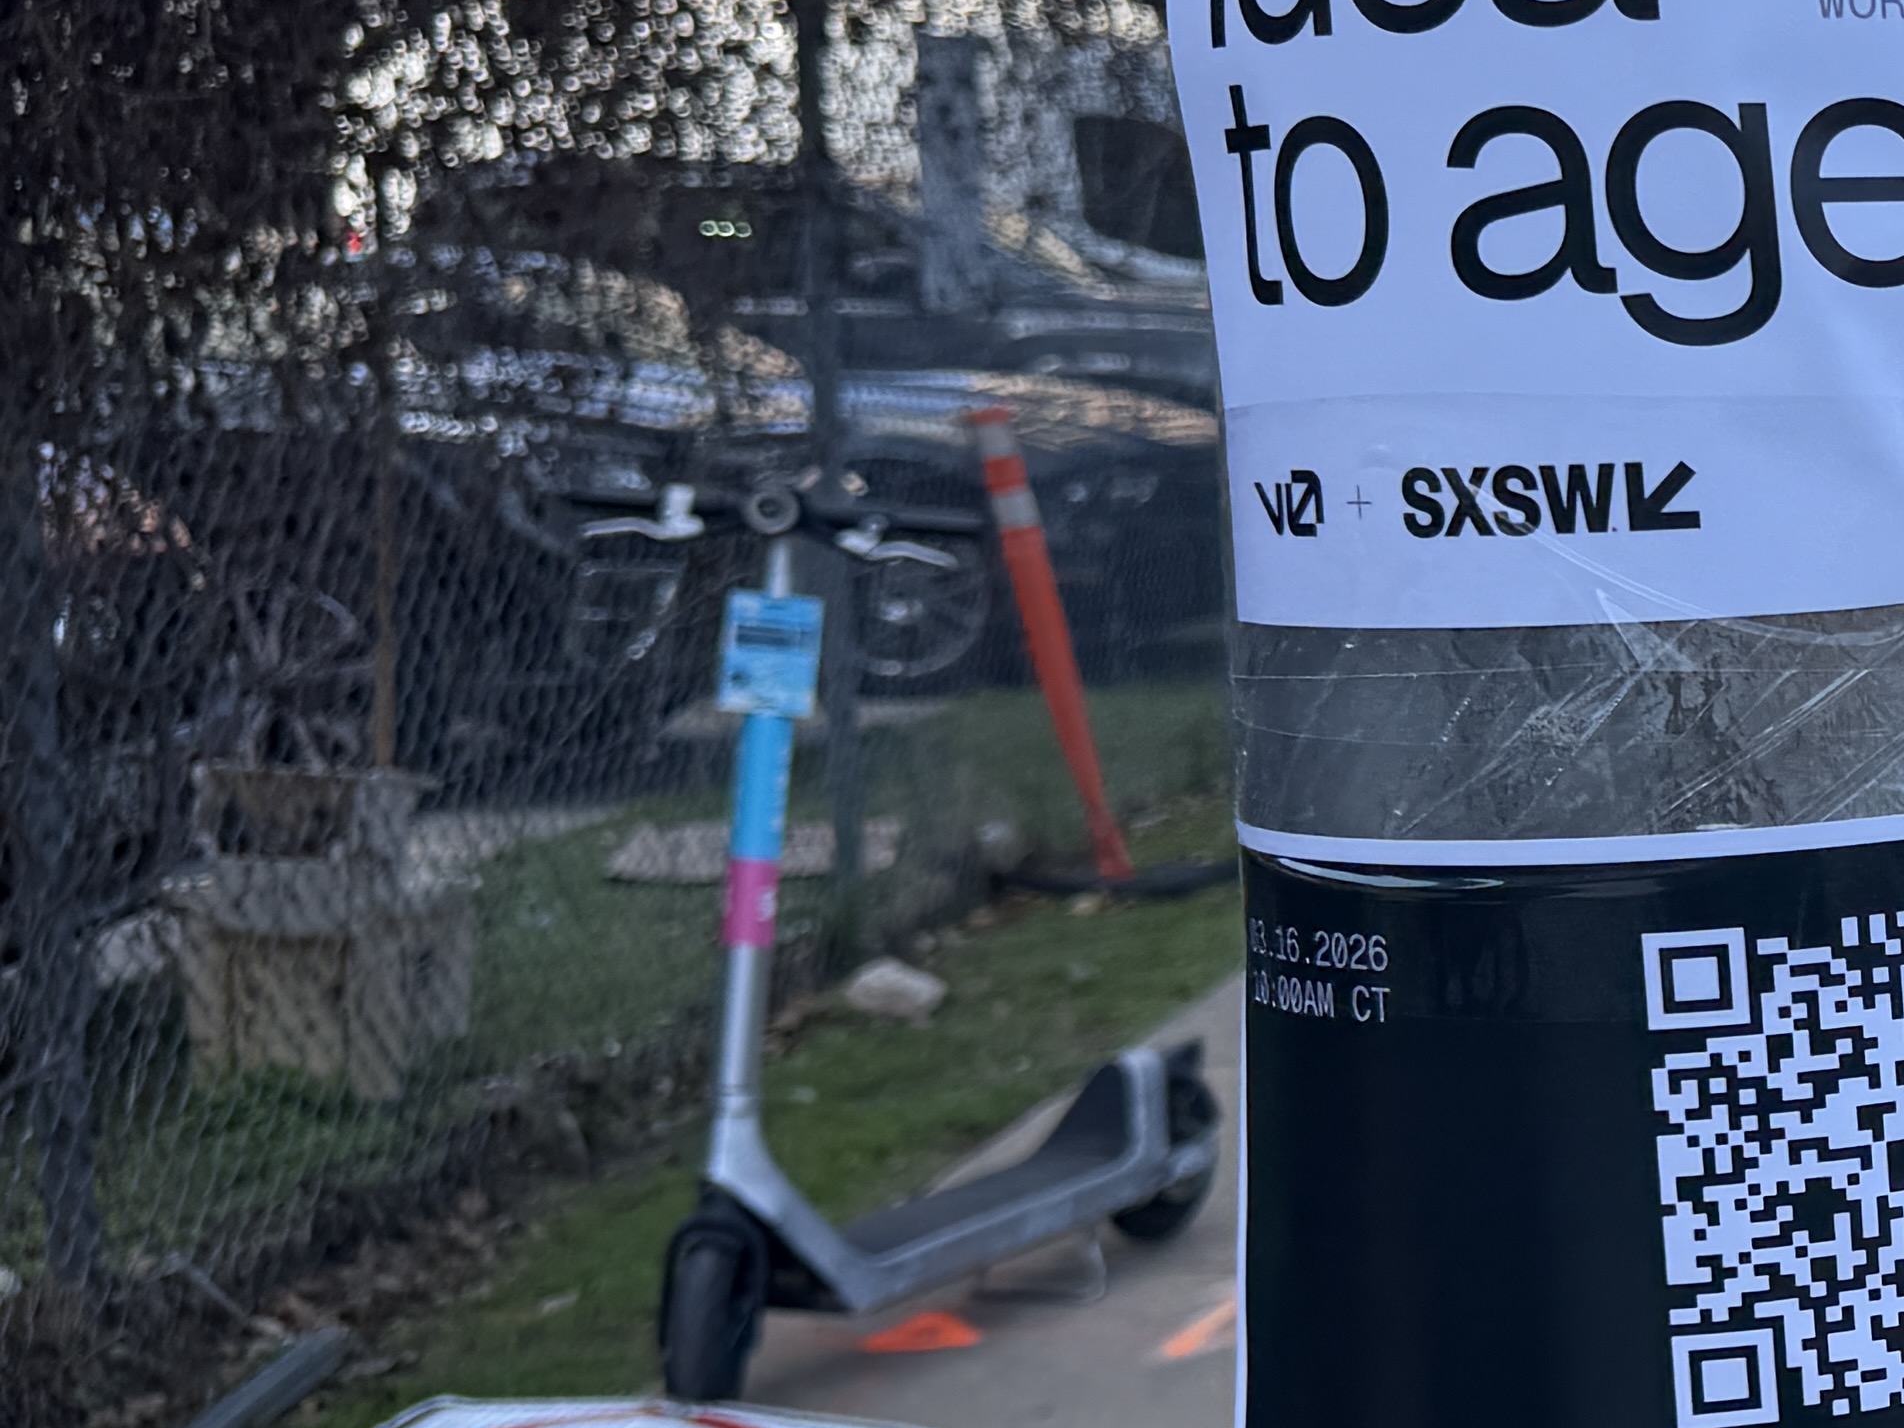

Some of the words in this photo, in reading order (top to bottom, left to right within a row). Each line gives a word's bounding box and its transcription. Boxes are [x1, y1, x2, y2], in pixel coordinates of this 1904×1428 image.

[1225, 85, 1388, 306] to
[1402, 463, 1614, 538] SXSW
[1352, 984, 1391, 1023] CT
